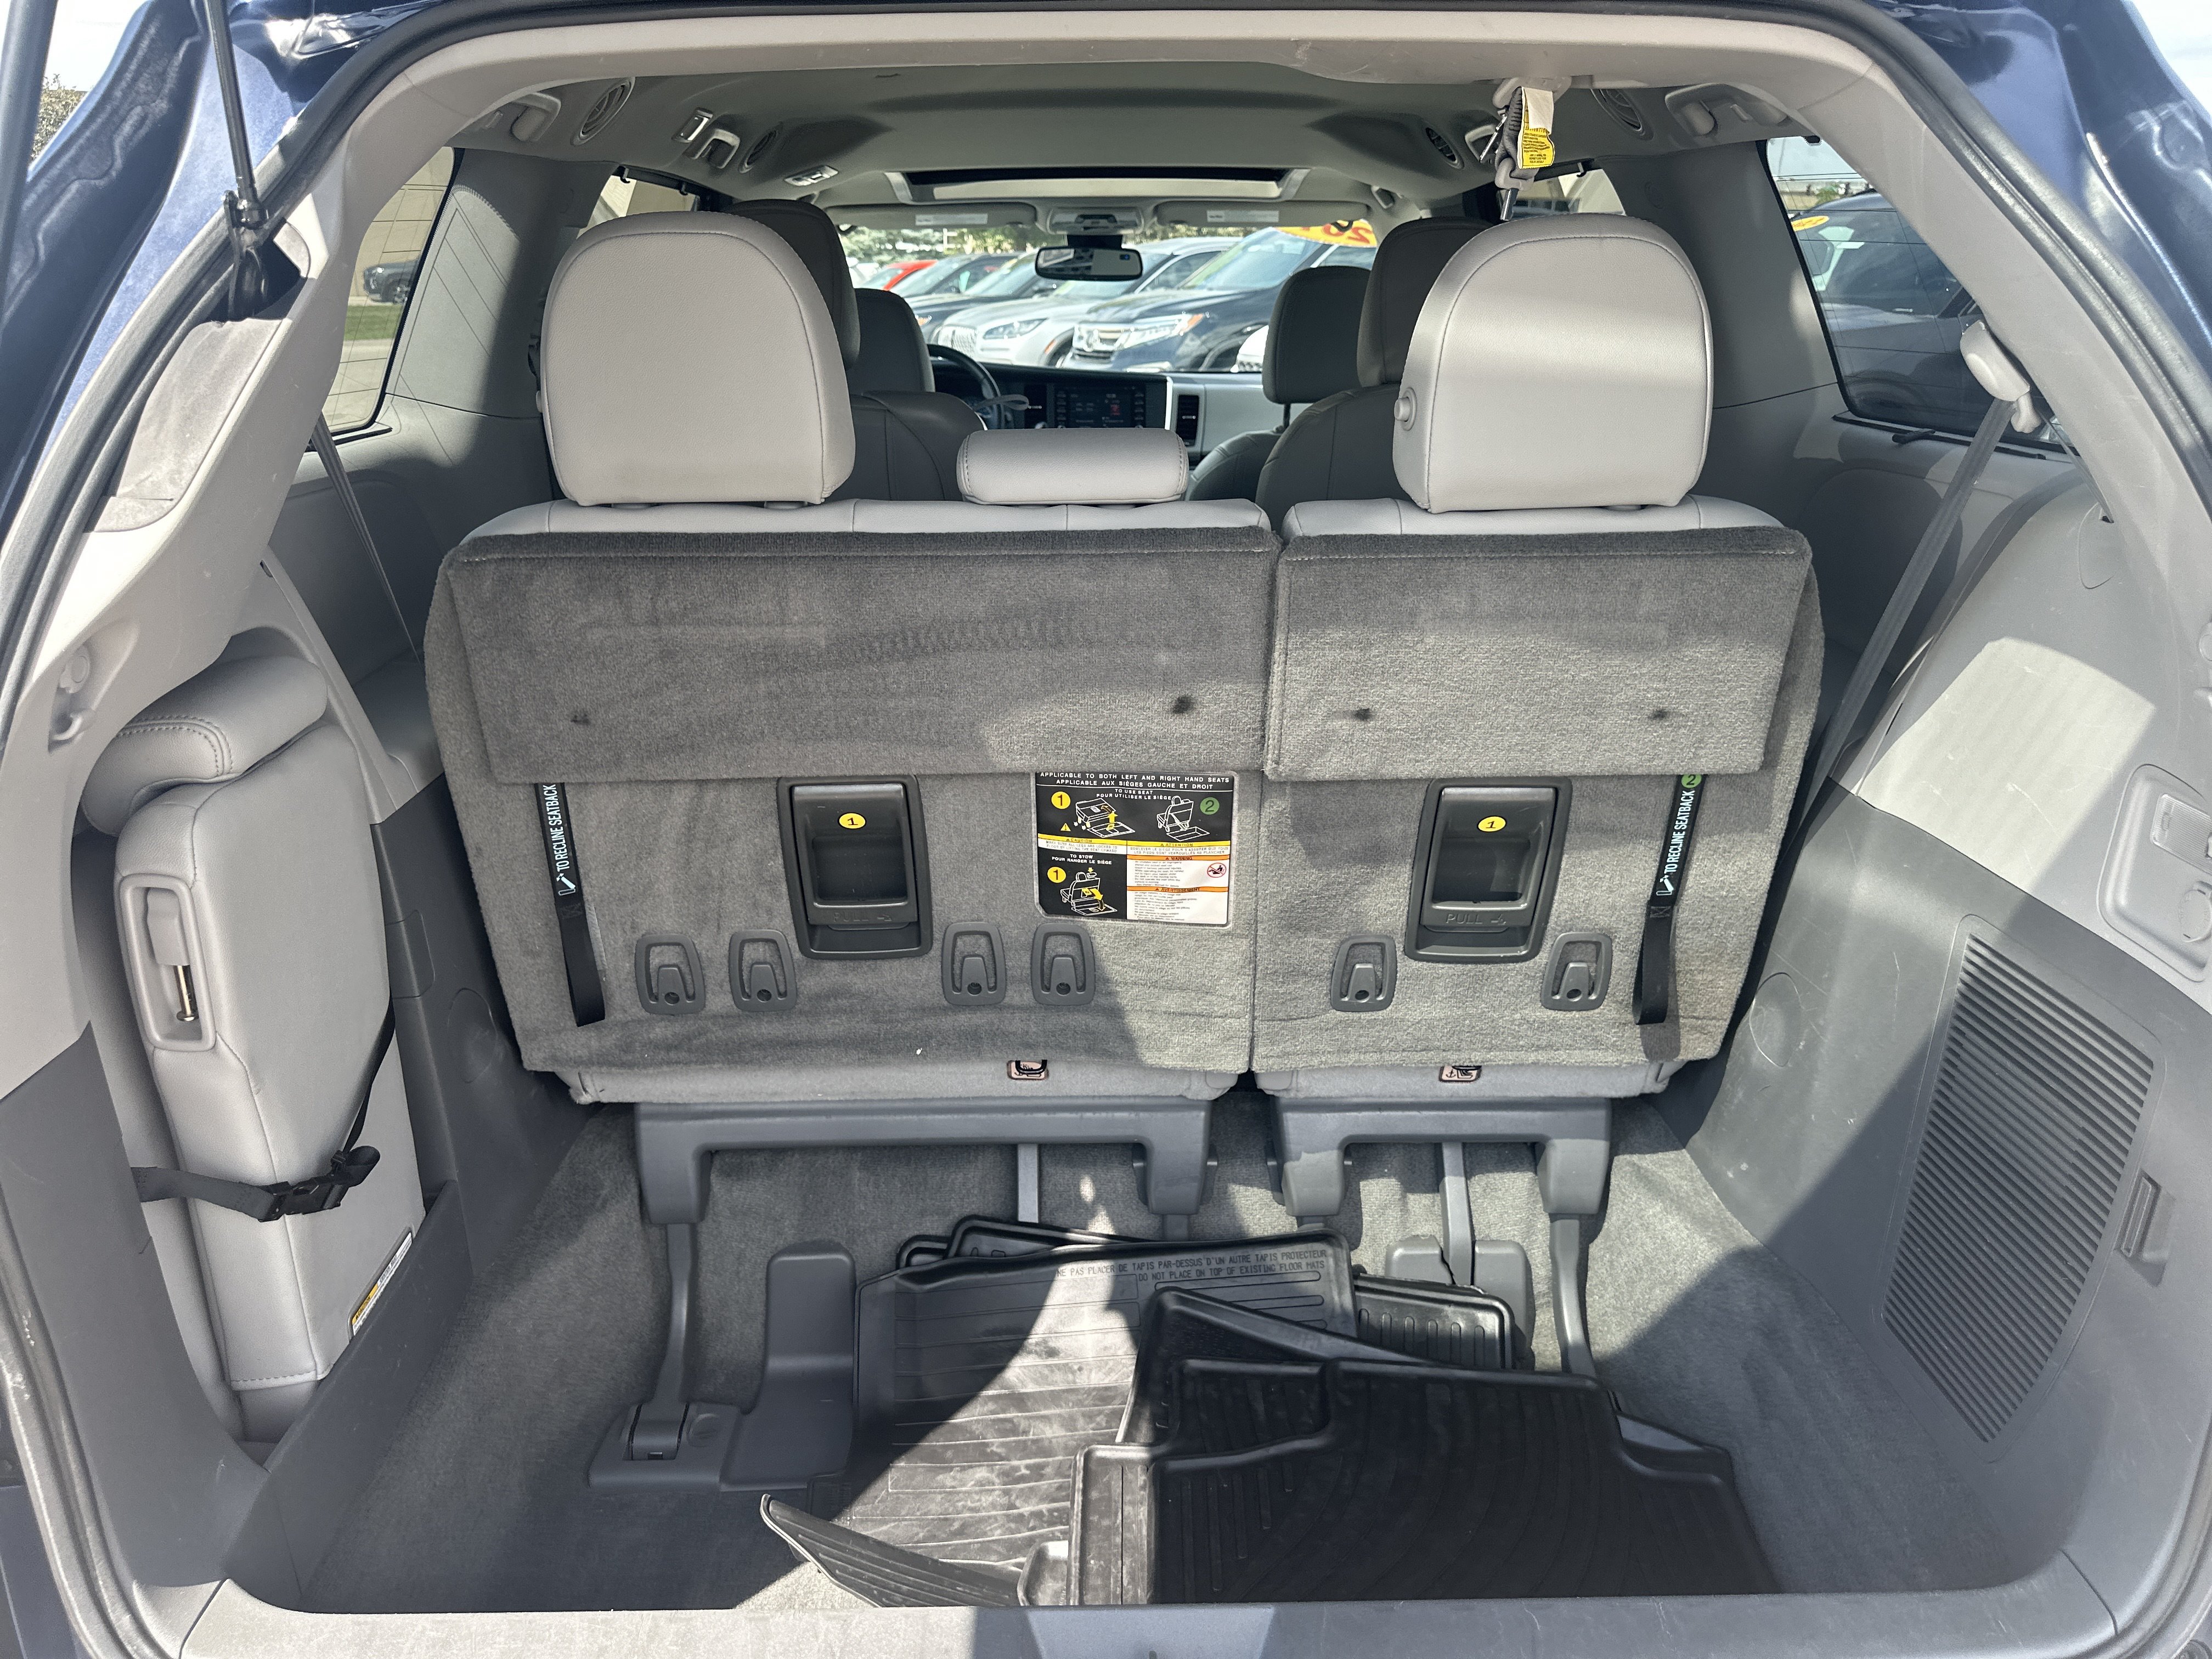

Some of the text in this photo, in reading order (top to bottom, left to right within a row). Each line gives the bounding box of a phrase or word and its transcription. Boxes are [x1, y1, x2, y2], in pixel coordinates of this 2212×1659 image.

[1686, 774, 1696, 785] 2
[1057, 794, 1063, 806] 1
[1205, 800, 1215, 812] 2
[847, 817, 858, 826] 1
[1485, 821, 1496, 829] 1
[543, 784, 569, 872] TO RECLINE SEATBACK
[1664, 790, 1695, 874] TO RECLINE SEATBACK
[1053, 869, 1059, 881] 1
[833, 912, 868, 922] PULL
[1446, 913, 1483, 924] PULL
[1057, 1250, 1327, 1277] NE PAS PLACER DE TAPIS PAR-DESSUS D'UN AUTRE TAPIS PROTECTEUR
[1139, 1261, 1325, 1282] DO NOT PLACE ON TOP OF EXISTING FLOOR MATS
